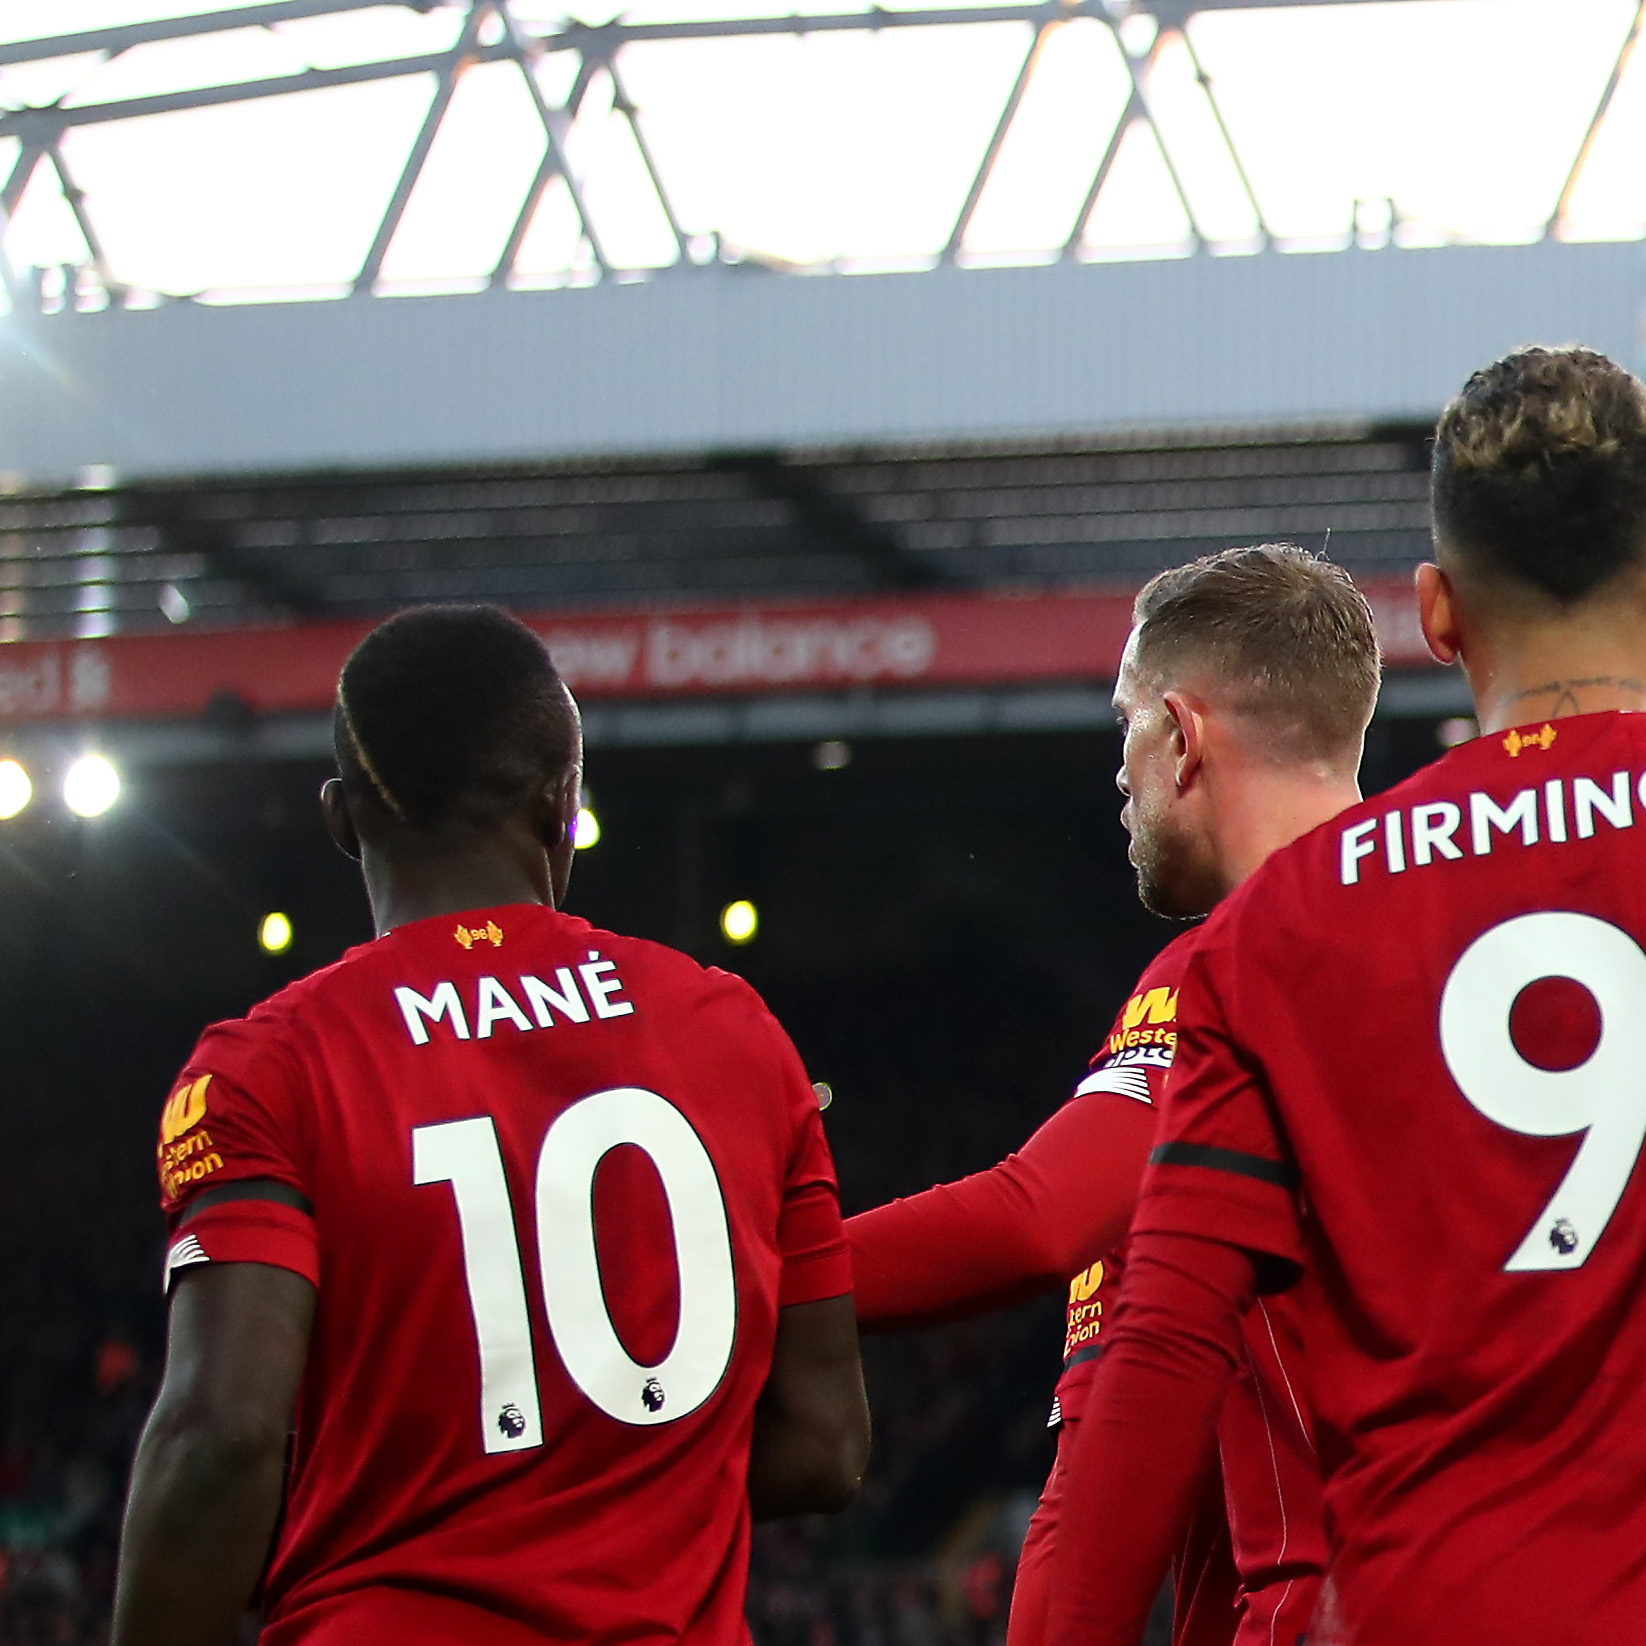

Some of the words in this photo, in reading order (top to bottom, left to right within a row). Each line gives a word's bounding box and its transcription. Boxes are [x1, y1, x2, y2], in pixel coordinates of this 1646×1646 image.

[646, 614, 936, 688] balance
[394, 950, 635, 1046] MANÉ
[1109, 1027, 1179, 1054] Weste
[411, 1086, 737, 1455] 10
